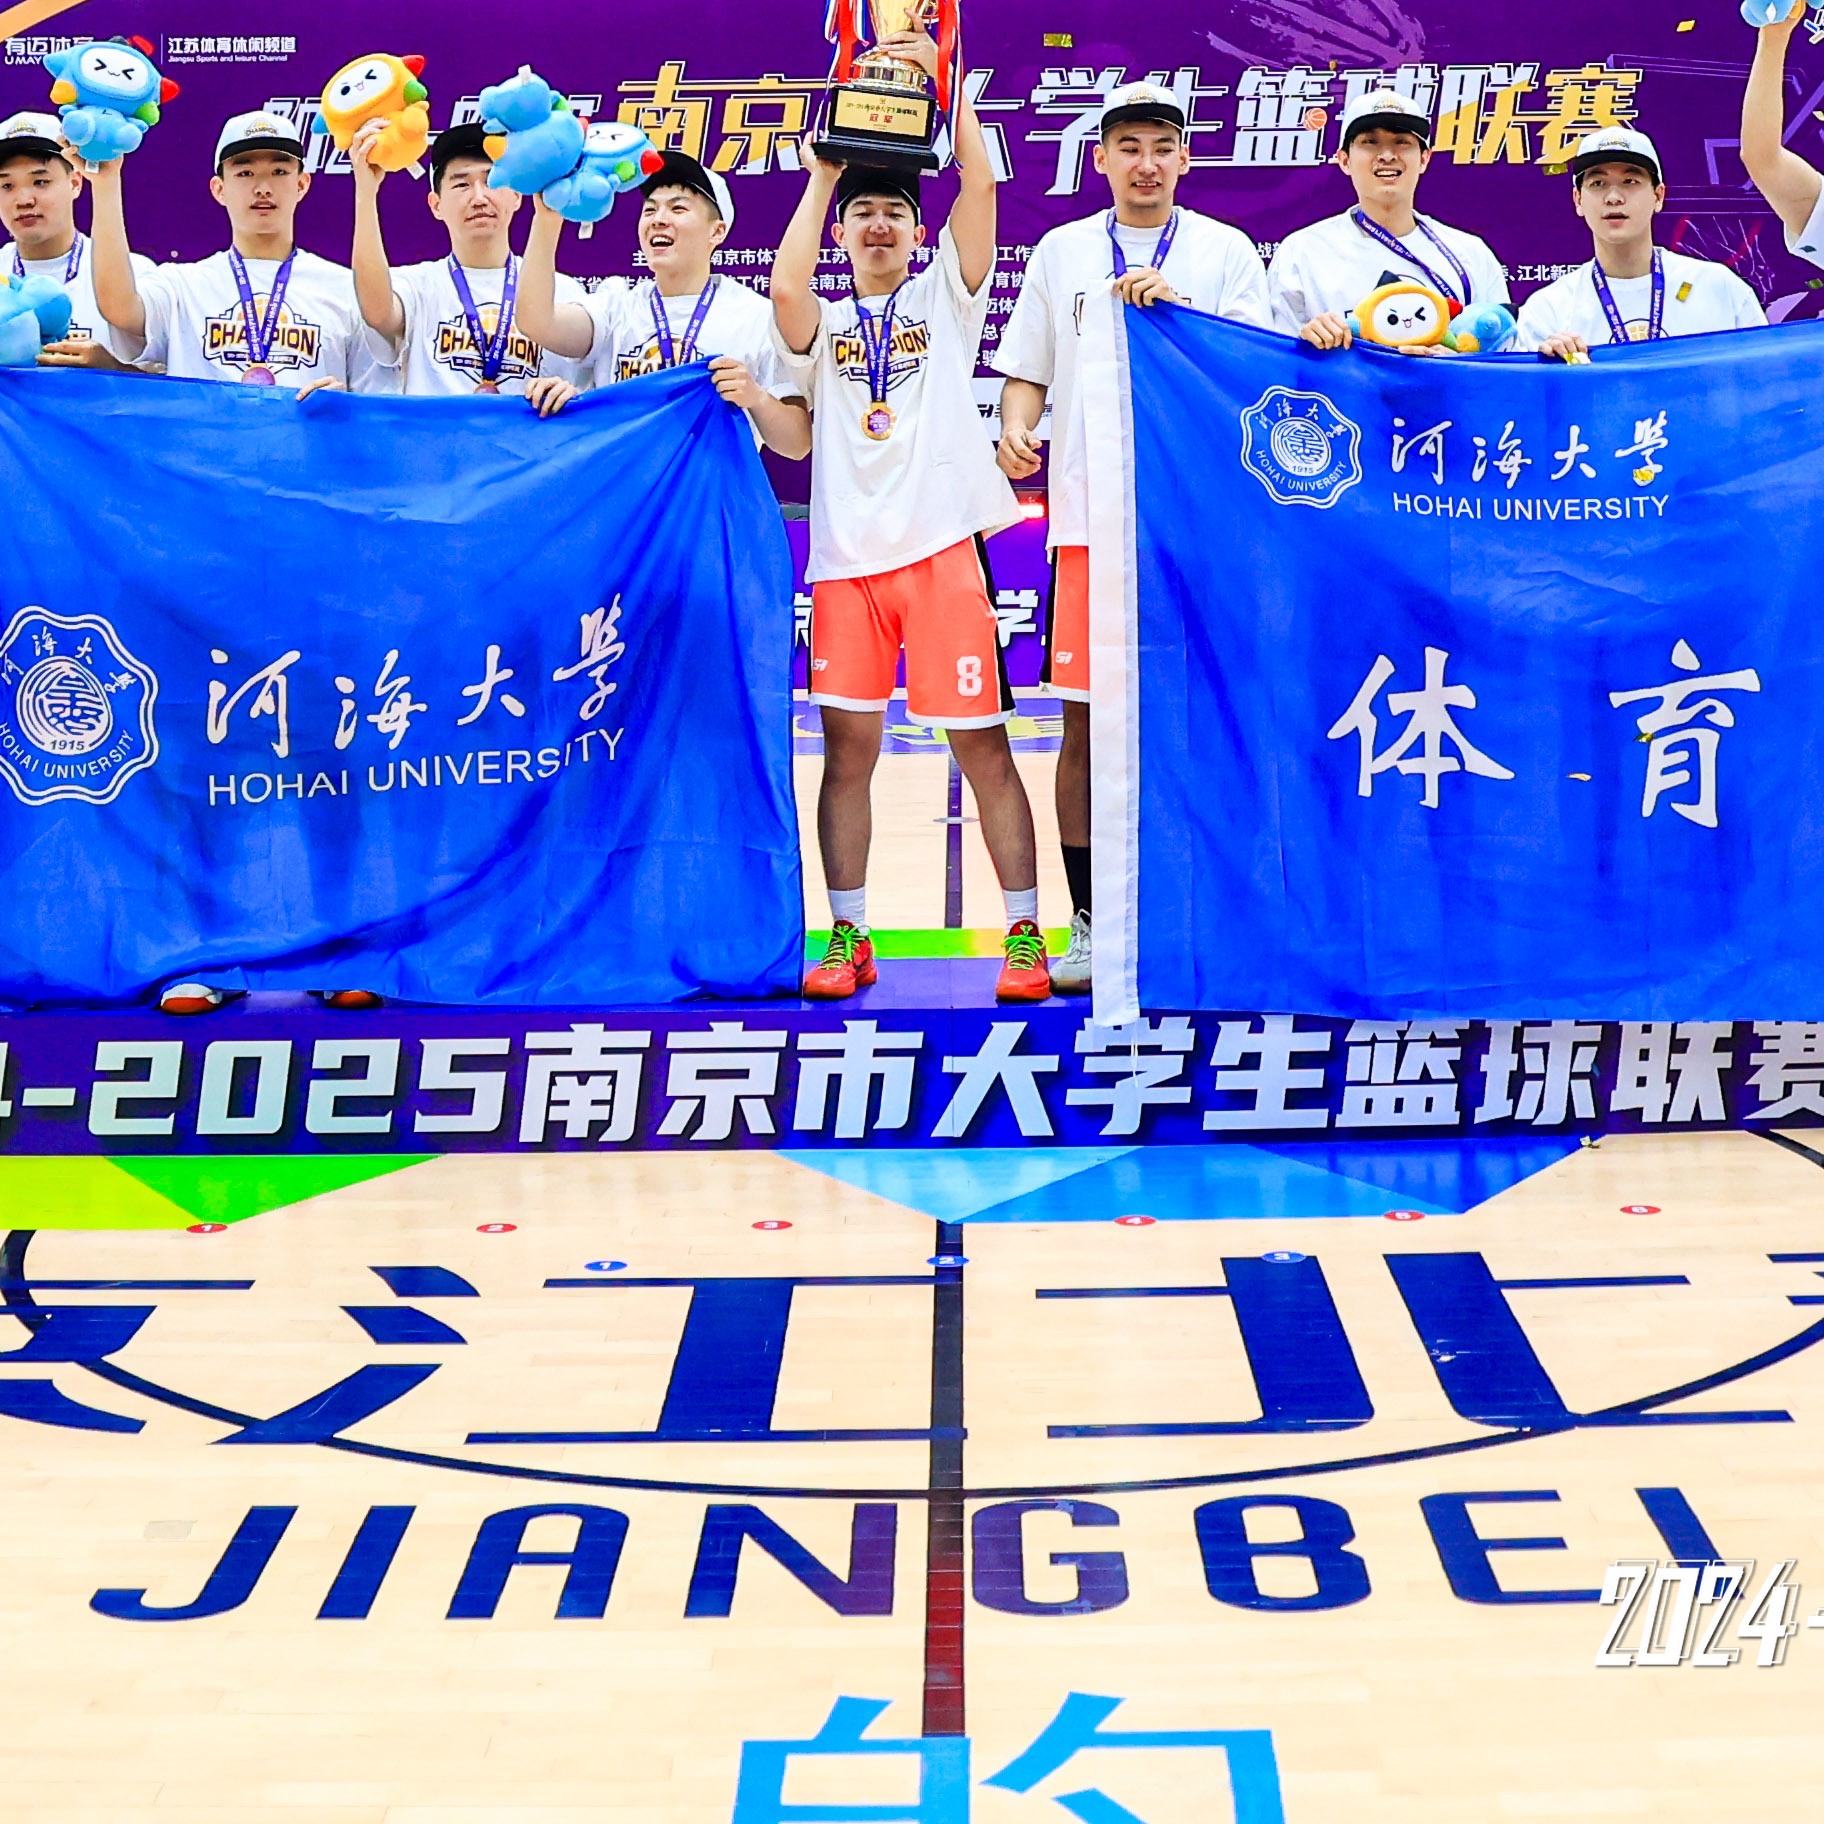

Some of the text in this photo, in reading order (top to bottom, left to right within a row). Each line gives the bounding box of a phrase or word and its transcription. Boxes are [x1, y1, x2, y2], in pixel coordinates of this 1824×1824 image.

[168, 35, 297, 54] 江苏体育休闲频道
[1393, 492, 1670, 521] HOHAI UNIVERSITY
[956, 655, 983, 697] 8
[43, 729, 134, 779] UNIVERSITY
[50, 738, 86, 751] 1915
[207, 727, 625, 807] HOHAI UNIVERSITY
[90, 1484, 1772, 1622] JIANGBEI
